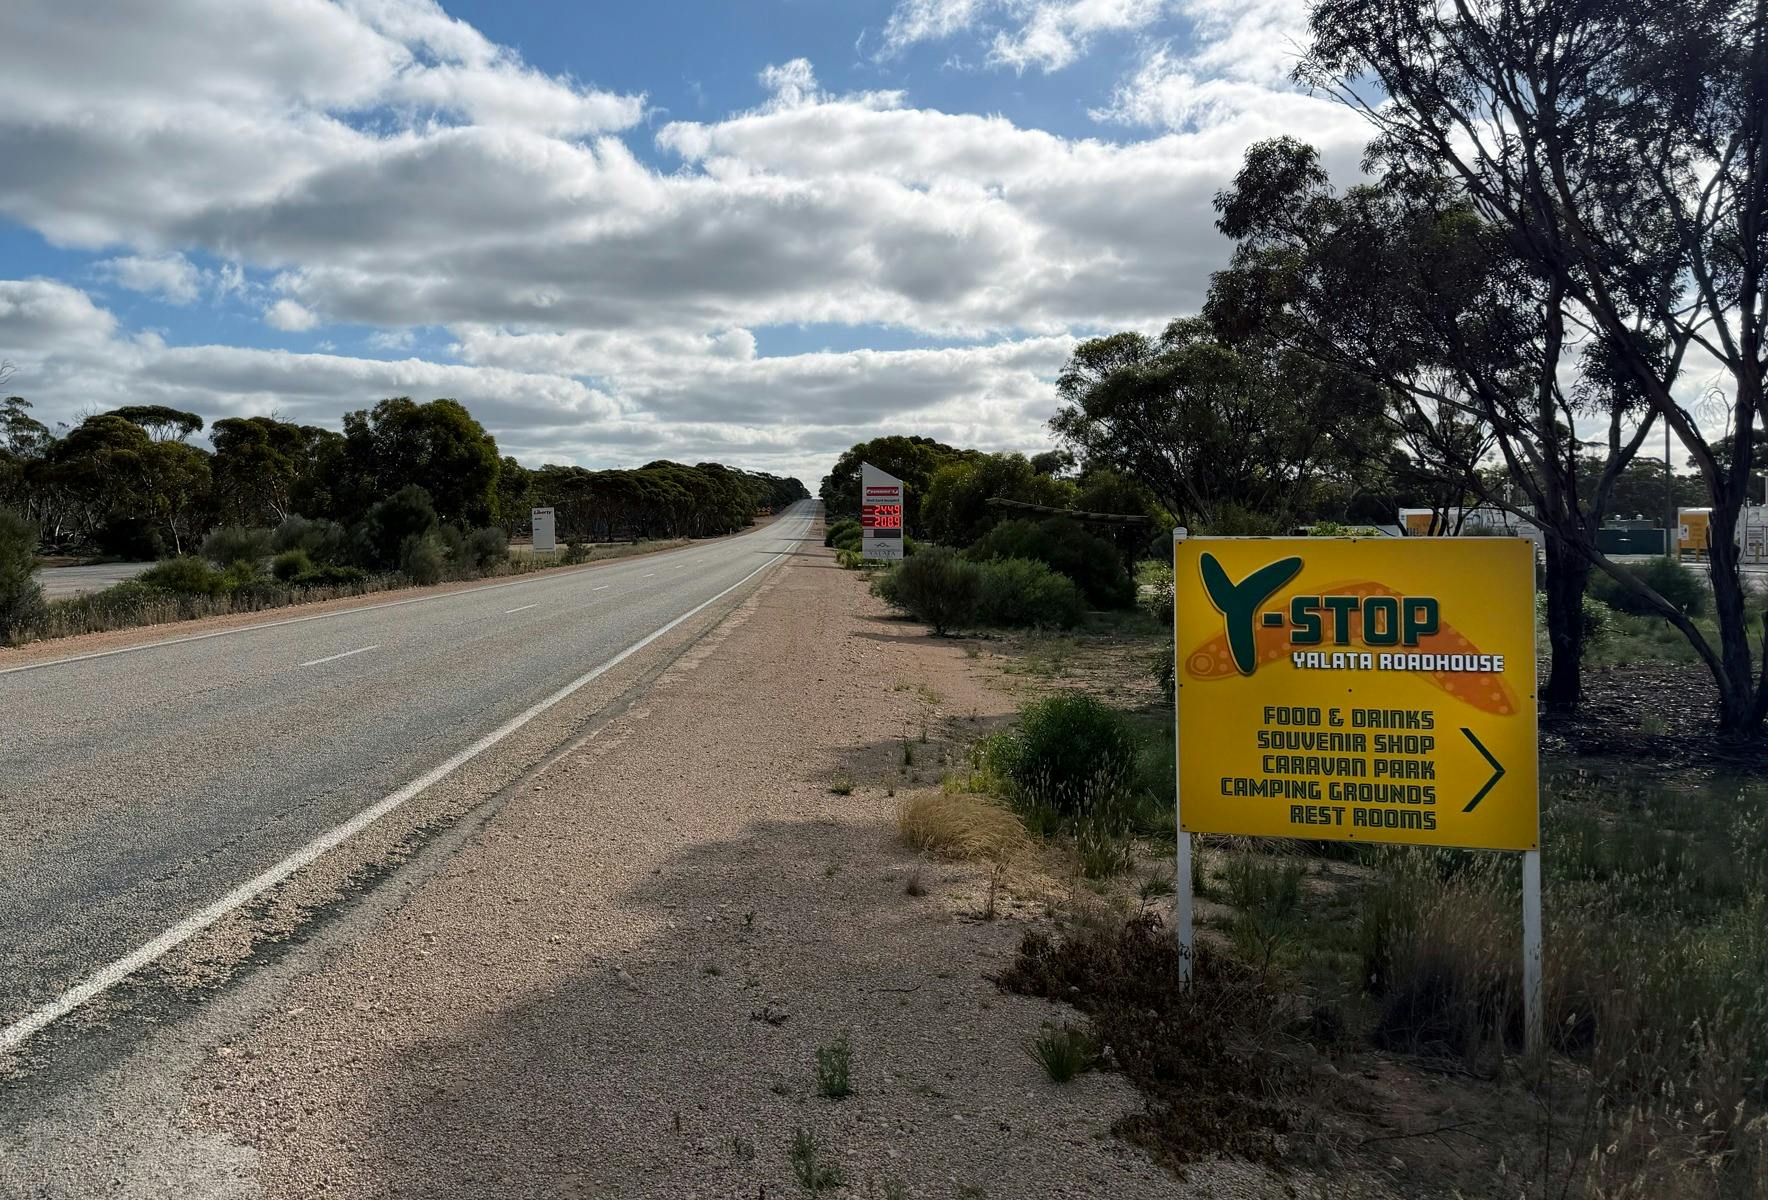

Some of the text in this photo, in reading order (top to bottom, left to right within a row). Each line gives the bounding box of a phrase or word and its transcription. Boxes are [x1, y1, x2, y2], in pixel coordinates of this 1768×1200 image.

[1292, 651, 1505, 673] YALATA ROADHOUSE
[1263, 706, 1435, 729] FOOD & DRINKS
[1257, 730, 1435, 755] SOUVENIR SHOP
[1262, 754, 1436, 780] CARAVAN PARK
[1220, 777, 1436, 805] CAMPING GROUNDS
[1290, 805, 1437, 830] REST ROOMS
